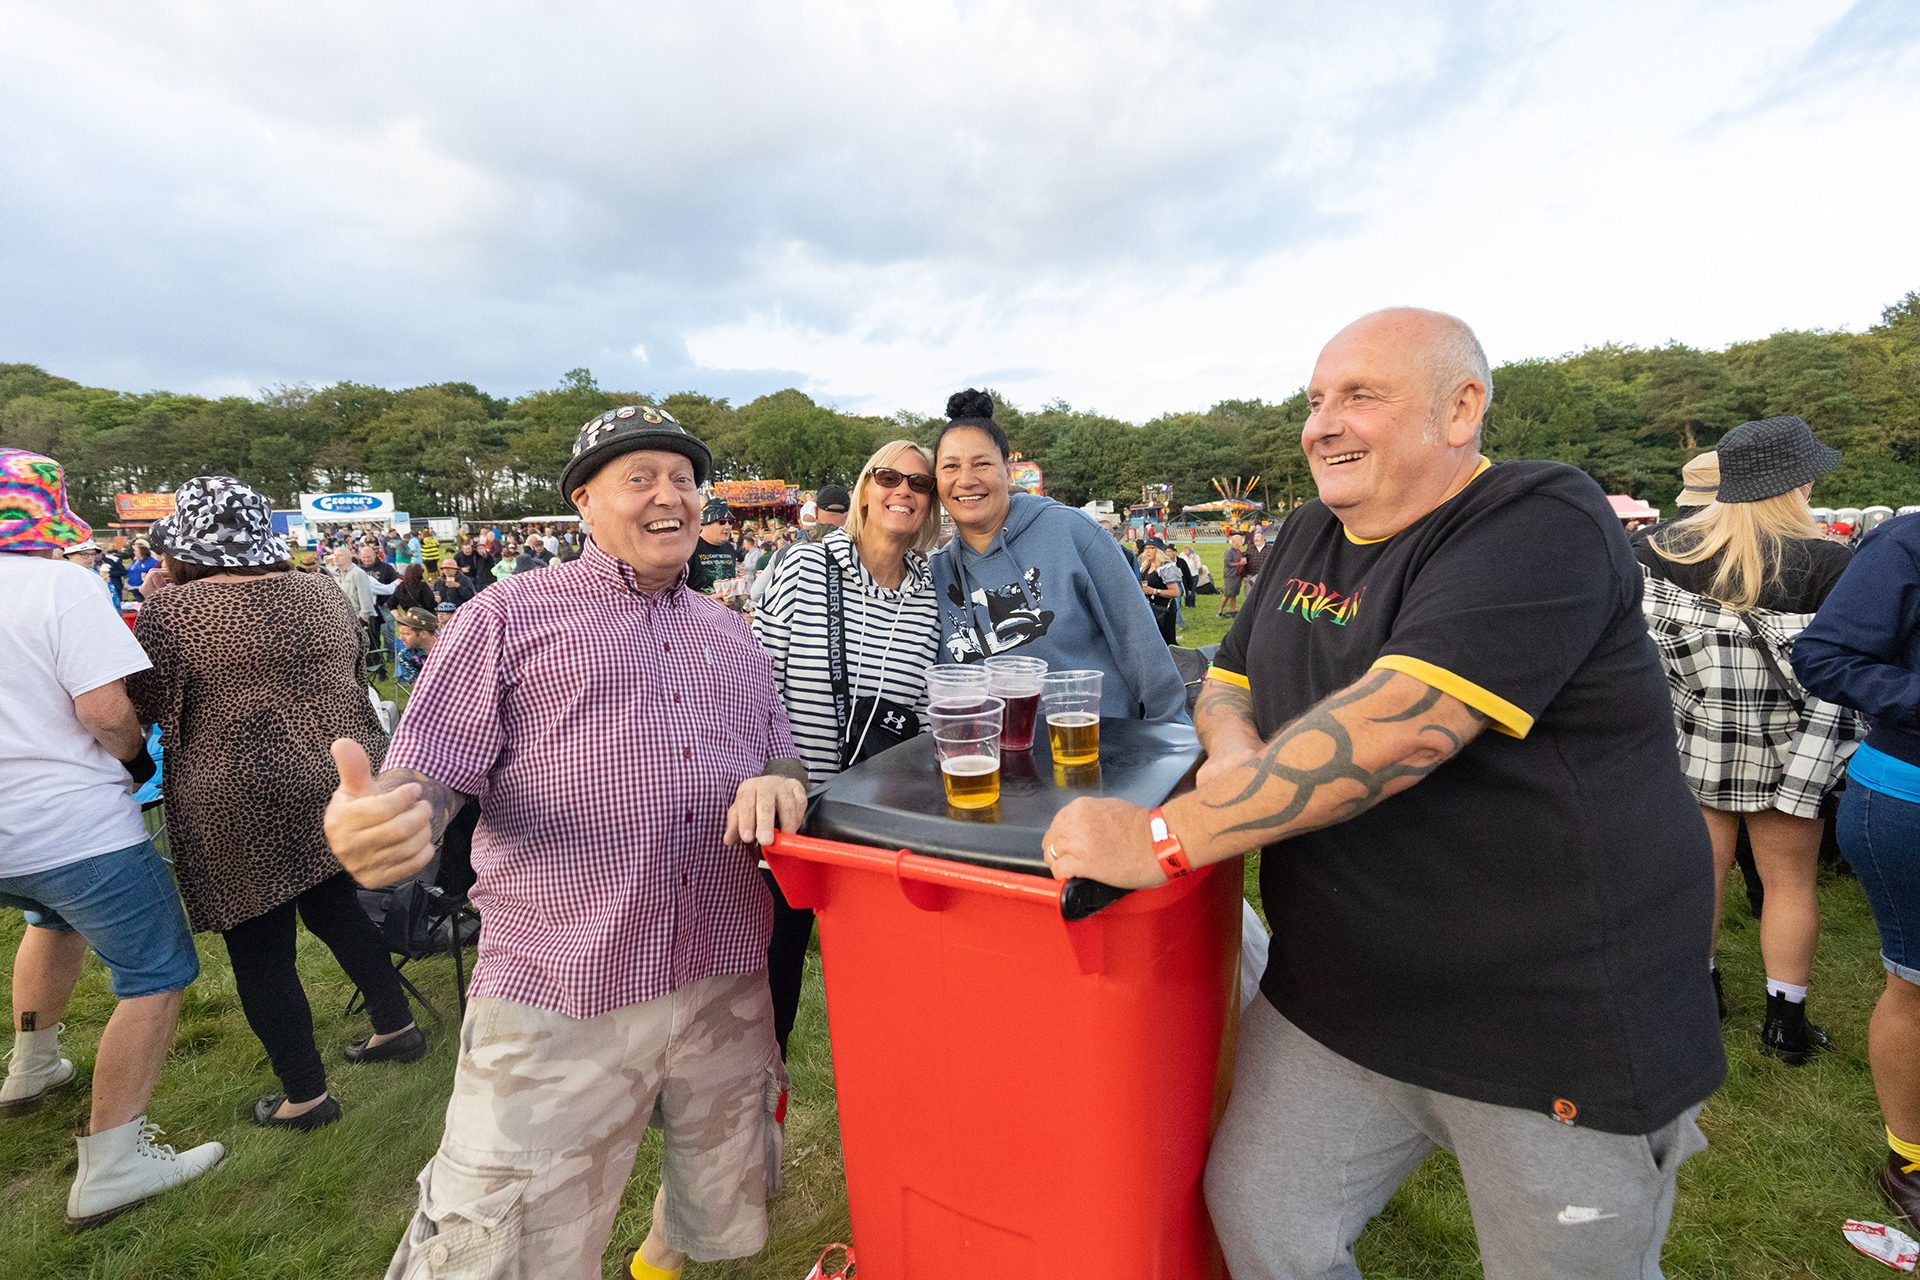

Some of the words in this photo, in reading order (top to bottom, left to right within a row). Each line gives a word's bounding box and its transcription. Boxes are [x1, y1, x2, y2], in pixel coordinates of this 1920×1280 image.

[319, 496, 374, 510] GEORGE'S
[828, 564, 840, 612] UNDER
[829, 615, 842, 681] ARMOUR
